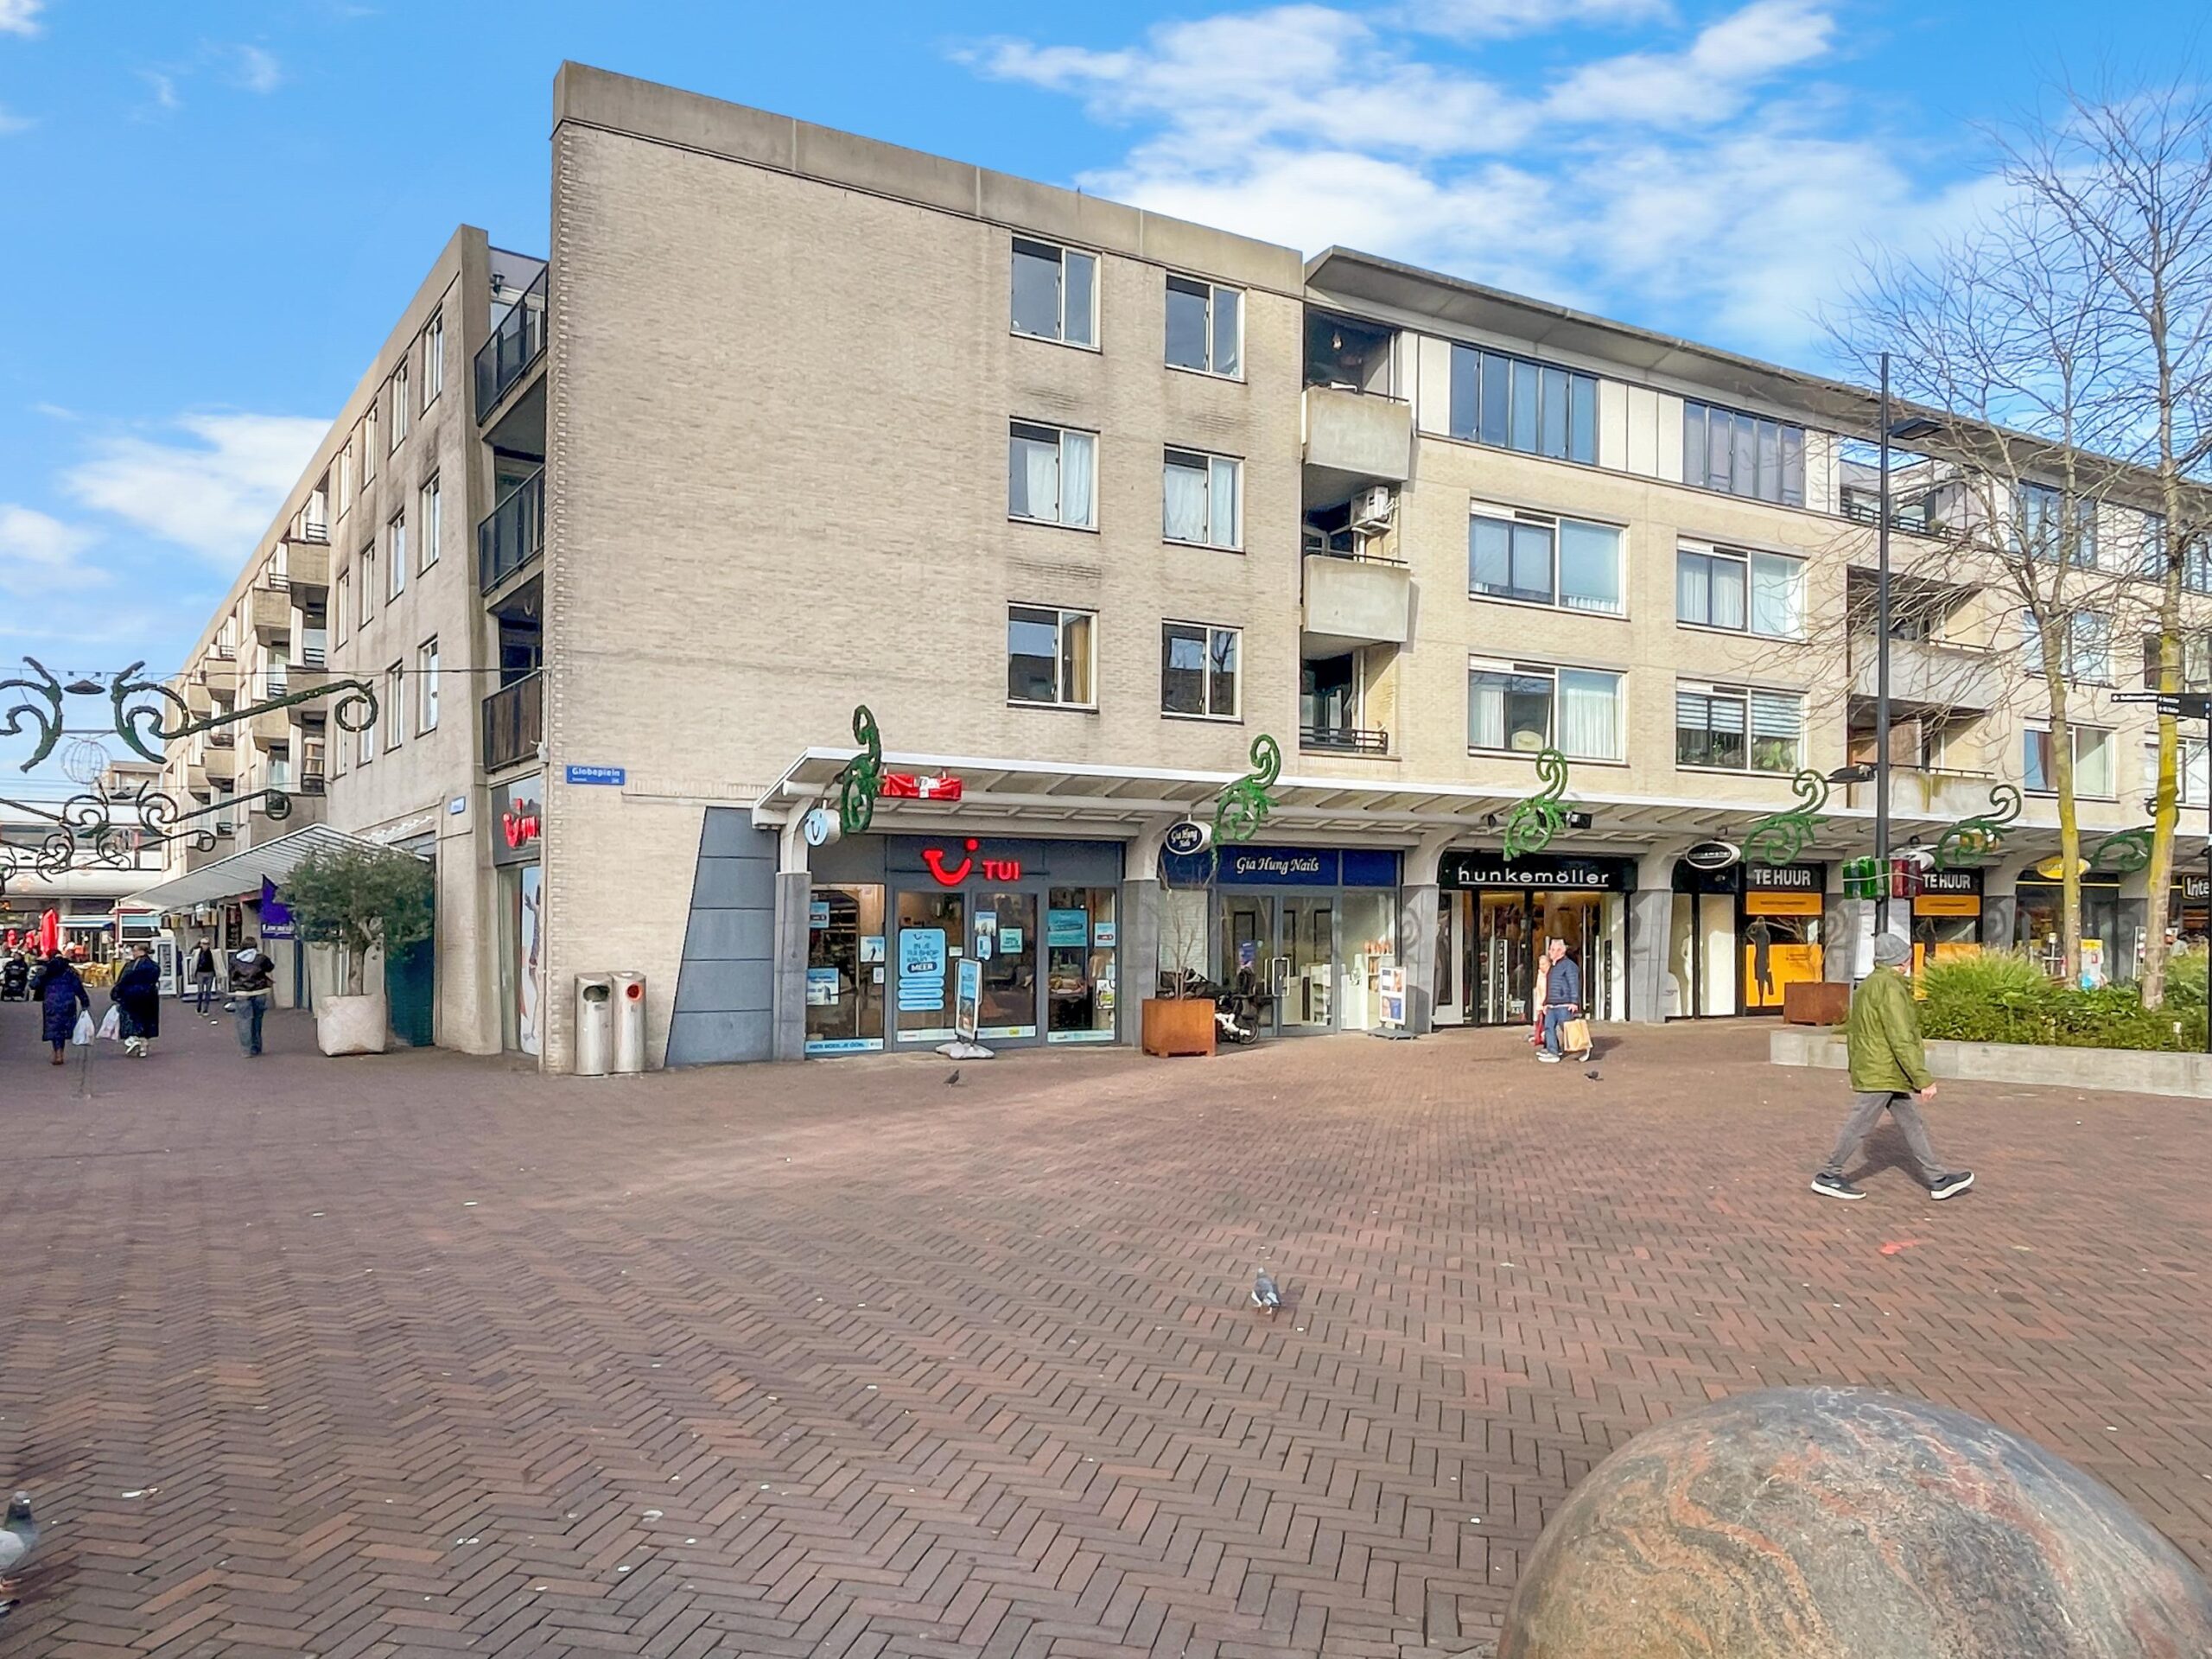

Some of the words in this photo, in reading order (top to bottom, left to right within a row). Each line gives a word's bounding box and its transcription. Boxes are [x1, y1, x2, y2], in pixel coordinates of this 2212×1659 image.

[571, 767, 620, 777] Globeplein
[982, 859, 1020, 880] TUI
[1236, 857, 1255, 874] Gia
[1257, 857, 1287, 875] Hung
[1290, 858, 1319, 872] Nails
[1458, 867, 1610, 884] hunkemöller
[1753, 869, 1771, 886] TE
[1773, 869, 1811, 887] HUUR
[1922, 874, 1938, 889] TE
[1938, 874, 1971, 889] HUUR
